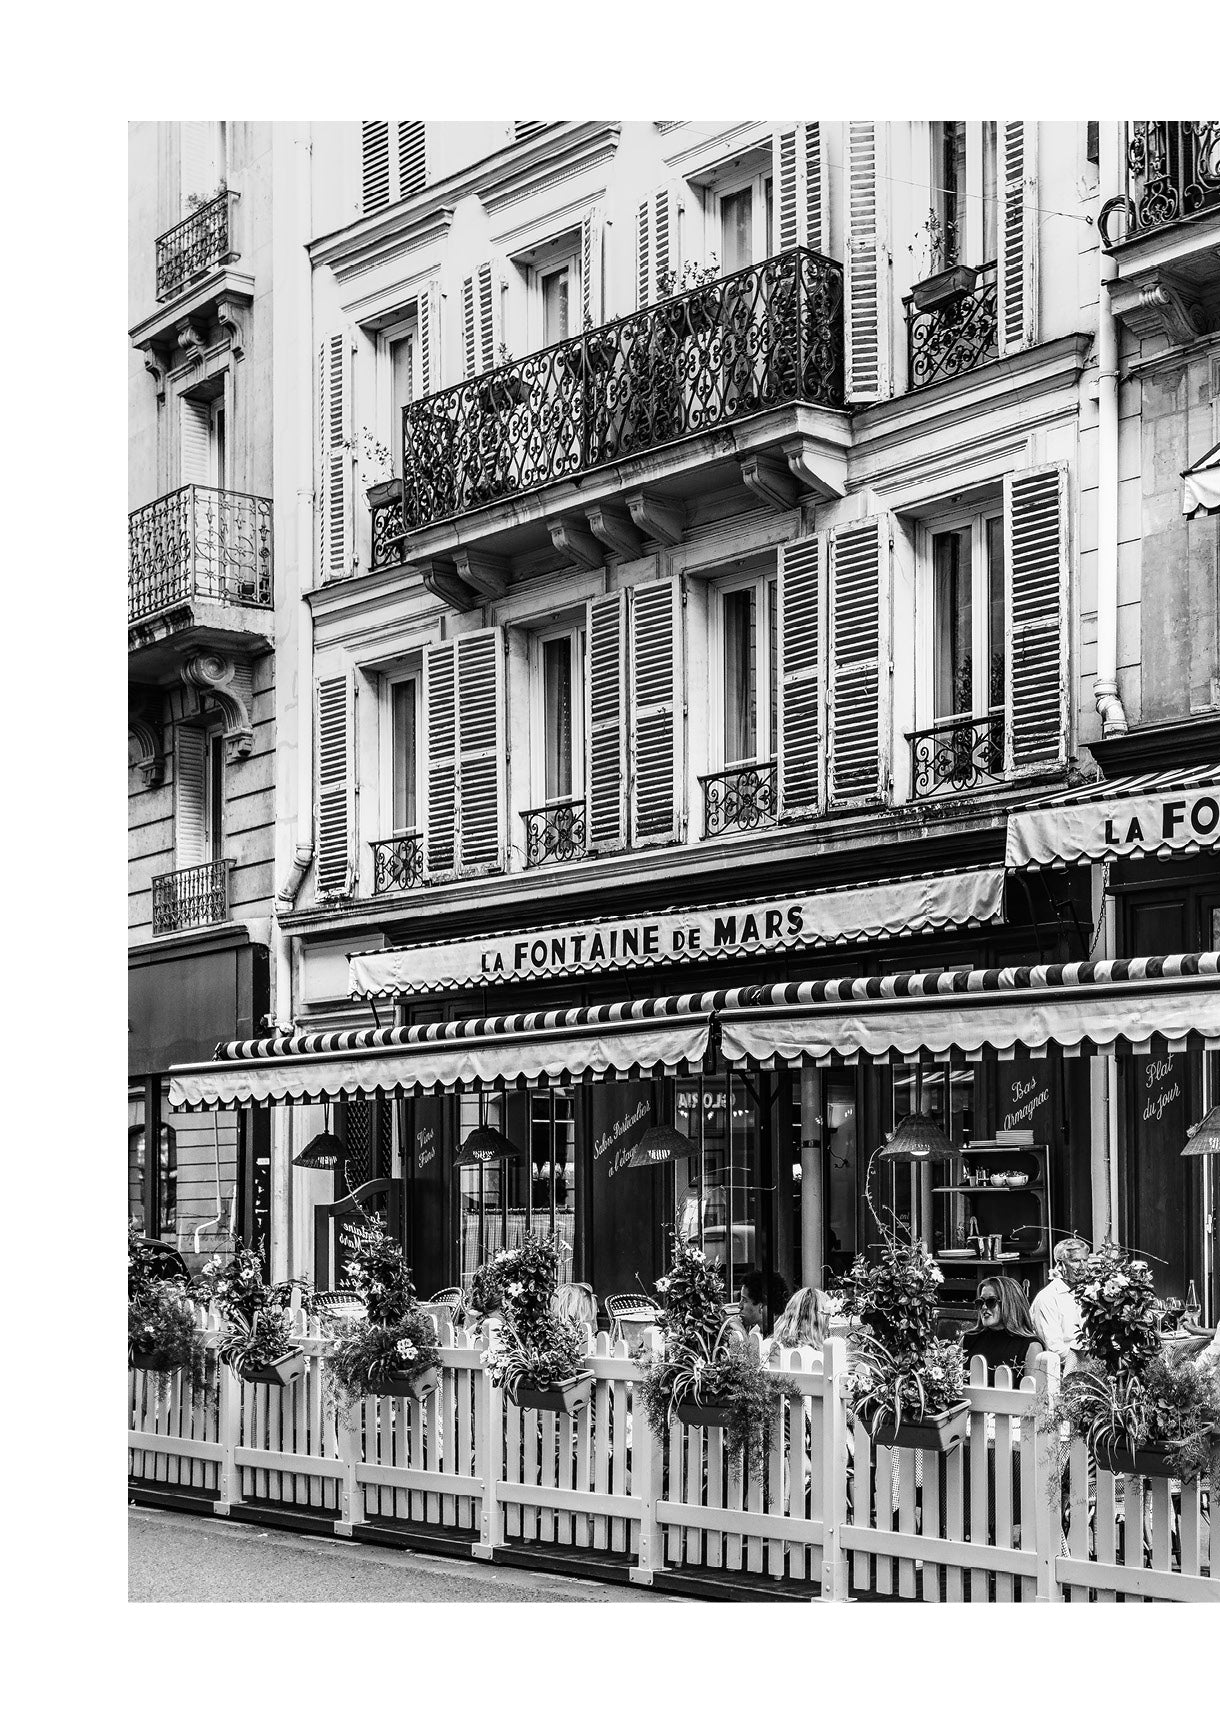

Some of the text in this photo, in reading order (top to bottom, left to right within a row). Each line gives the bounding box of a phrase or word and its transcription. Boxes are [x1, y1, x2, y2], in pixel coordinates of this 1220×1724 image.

[1104, 816, 1145, 846] LA
[481, 905, 804, 973] LA FONTAINE DE MARS
[1011, 1075, 1037, 1103] Bas
[1145, 1052, 1175, 1089] Plat
[1143, 1082, 1181, 1121] du jour
